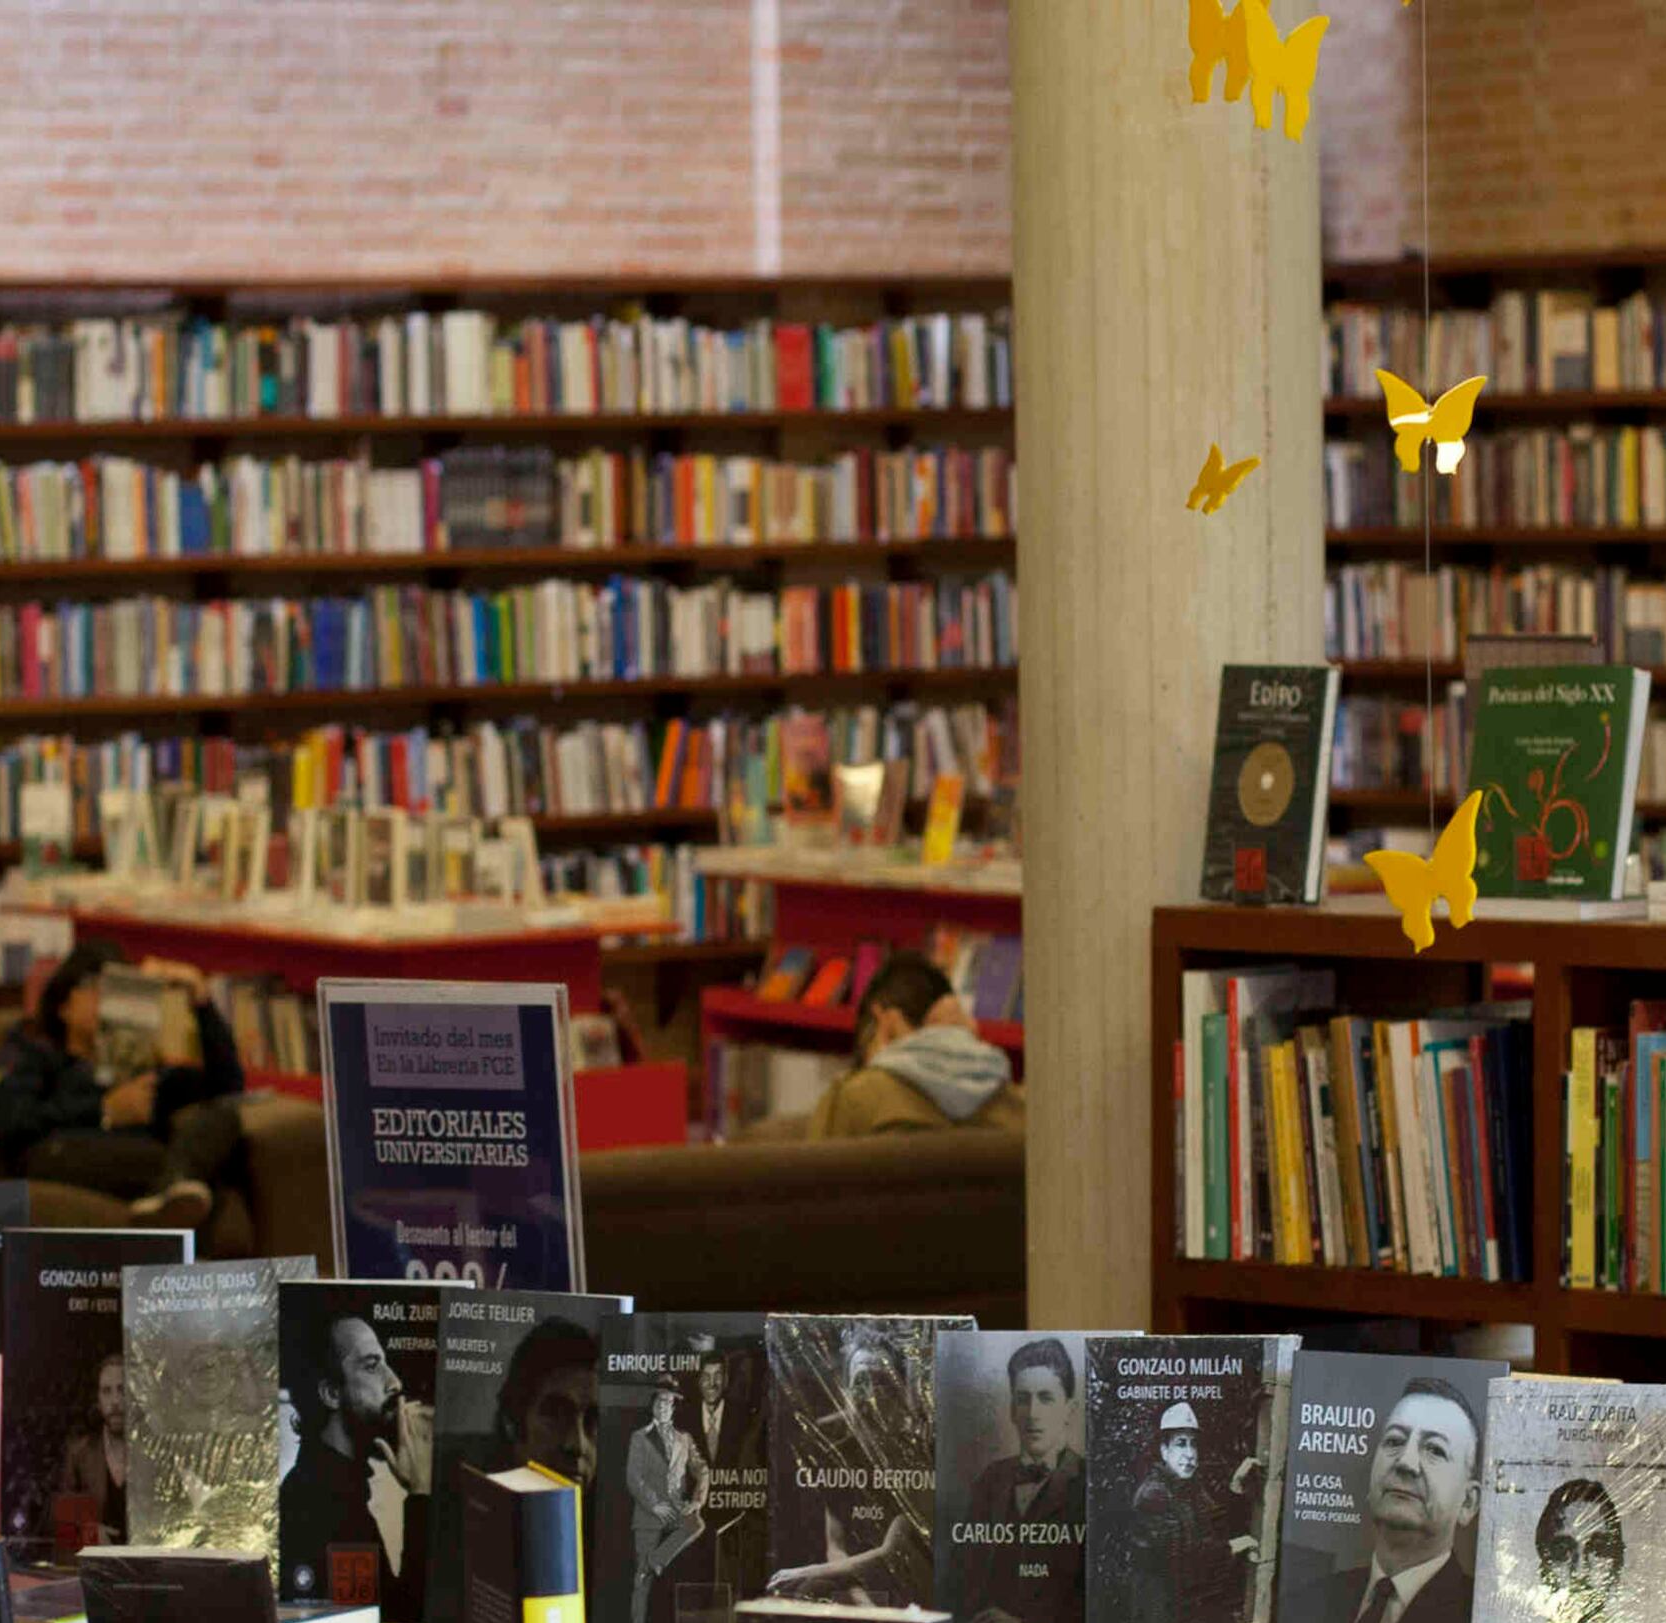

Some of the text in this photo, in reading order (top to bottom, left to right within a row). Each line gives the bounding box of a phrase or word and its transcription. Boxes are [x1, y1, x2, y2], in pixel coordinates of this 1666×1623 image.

[1555, 685, 1616, 704] Siglo XX
[375, 1026, 512, 1049] Invitado del mes
[483, 1056, 515, 1076] FCE
[372, 1108, 527, 1139] EDITORIALES
[375, 1140, 529, 1167] UNIVERSITARIAS
[39, 1270, 99, 1289] GONZALO
[151, 1272, 256, 1292] GONZALO ROJAS
[373, 1303, 405, 1322] RAÚL
[448, 1301, 536, 1325] JORGE TEILLIER
[446, 1337, 488, 1353] MUERTES
[445, 1359, 503, 1375] MARAVILLAS
[607, 1354, 701, 1373] ENRIQUE LIHN
[1117, 1354, 1243, 1377] GONZALO MILLÁN
[1117, 1385, 1223, 1400] GABINETE DE PAPEL
[1300, 1403, 1376, 1429] BRAULIO
[1298, 1432, 1369, 1455] ARENAS
[710, 1468, 739, 1487] UNA
[796, 1468, 869, 1489] CLAUDIO
[1296, 1473, 1343, 1490] LA CASA
[1295, 1491, 1354, 1508] FANTASMA
[851, 1505, 885, 1521] ADIÓS
[1328, 1512, 1362, 1524] POEMAS
[952, 1522, 1071, 1545] CARLOS PEZOA
[1018, 1562, 1049, 1579] NADA
